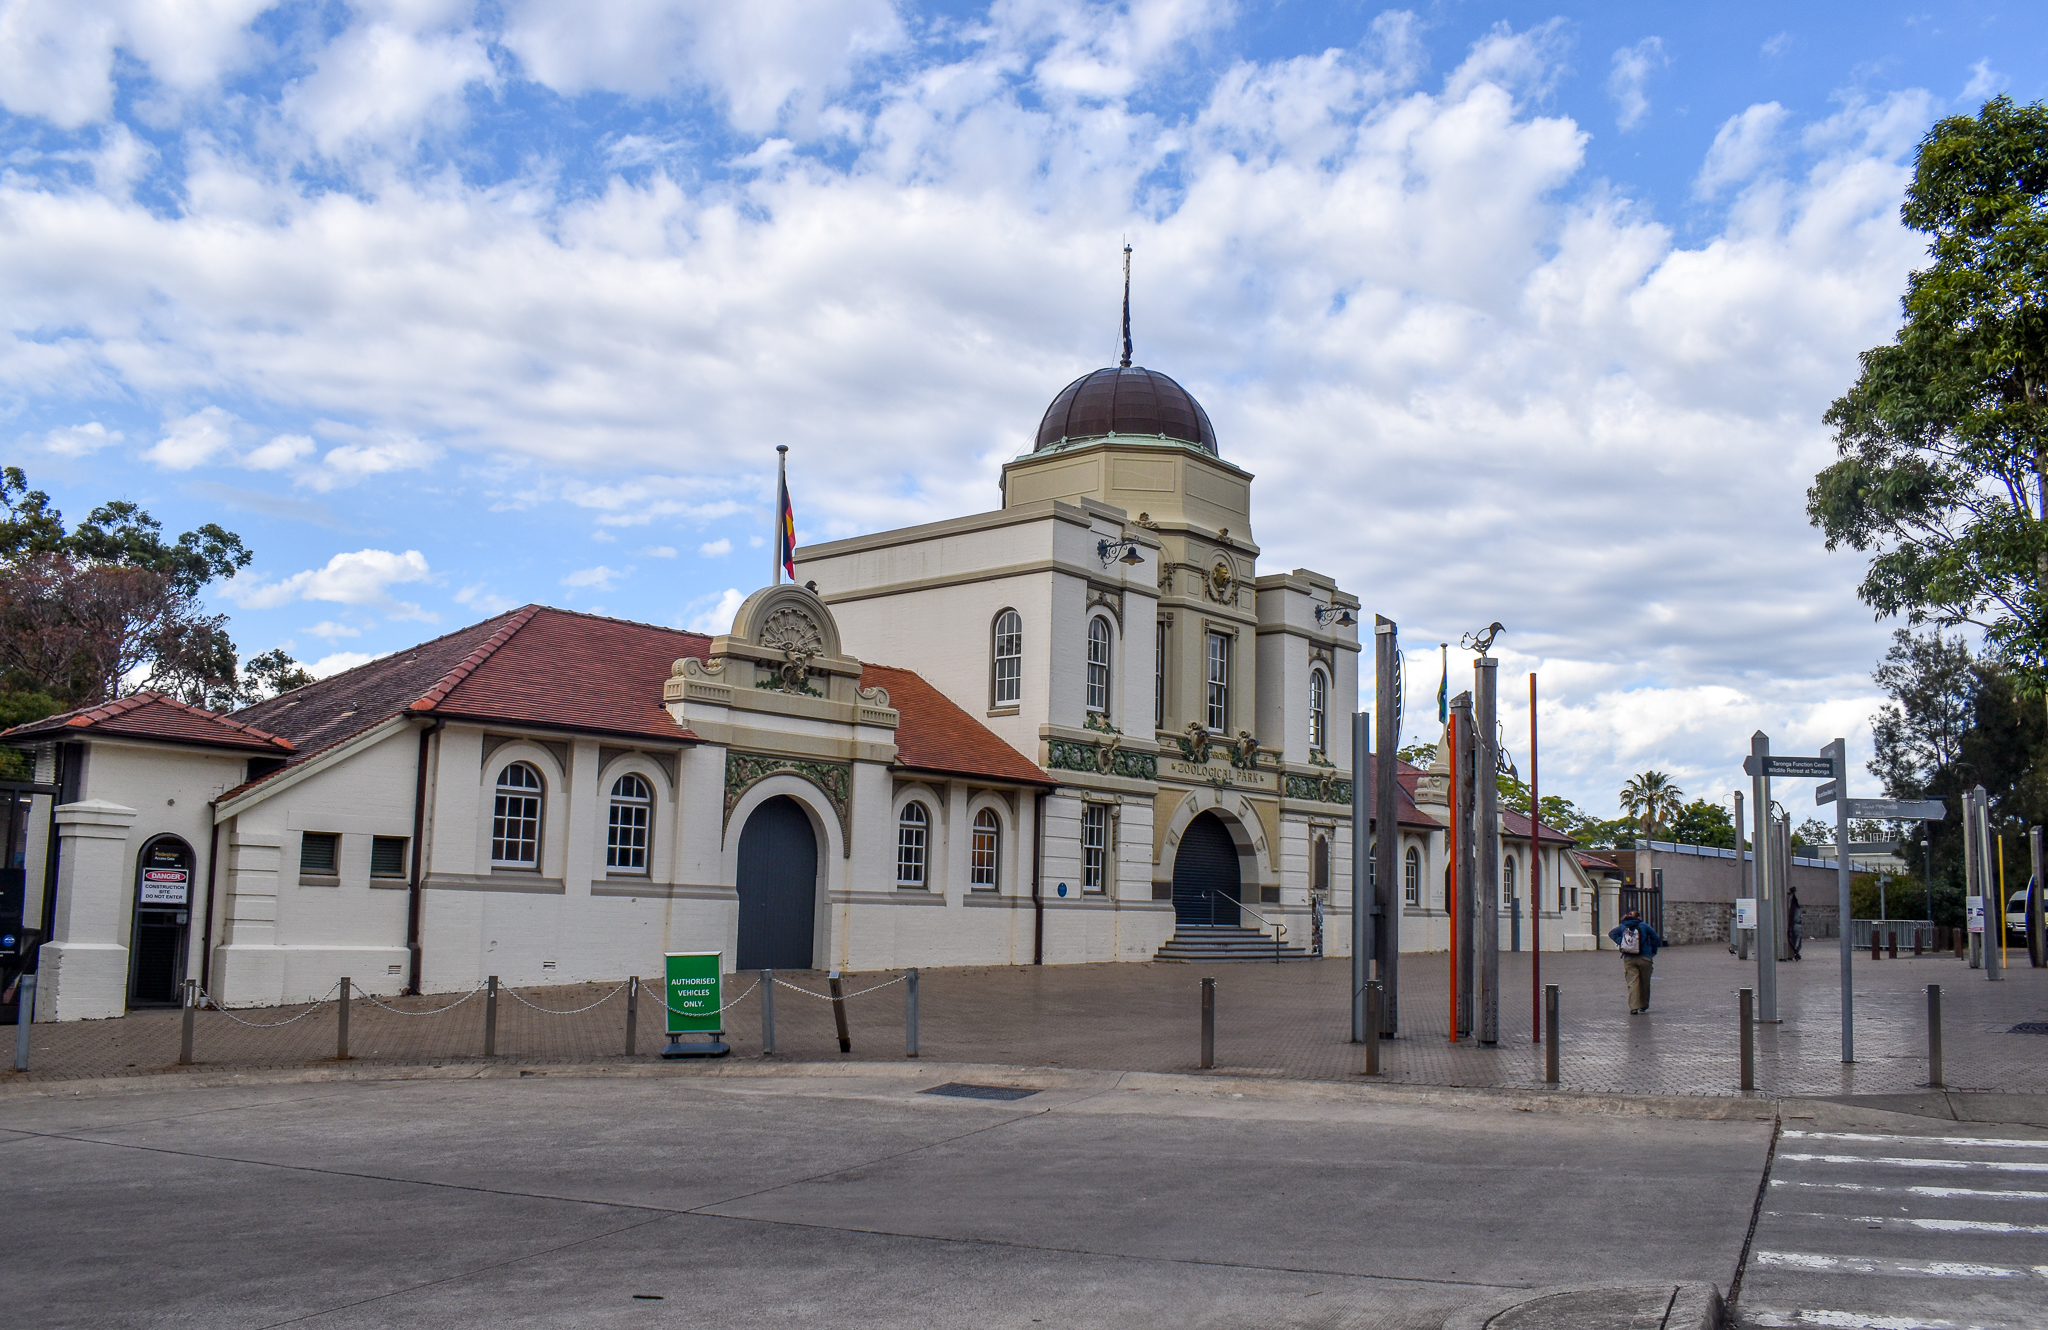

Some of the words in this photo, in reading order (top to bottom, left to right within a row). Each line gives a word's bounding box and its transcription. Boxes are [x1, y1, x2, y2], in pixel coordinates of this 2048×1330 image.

[1772, 760, 1792, 768] Taronga
[1178, 763, 1234, 780] ZOOLOGICAL
[1236, 771, 1258, 783] PARK
